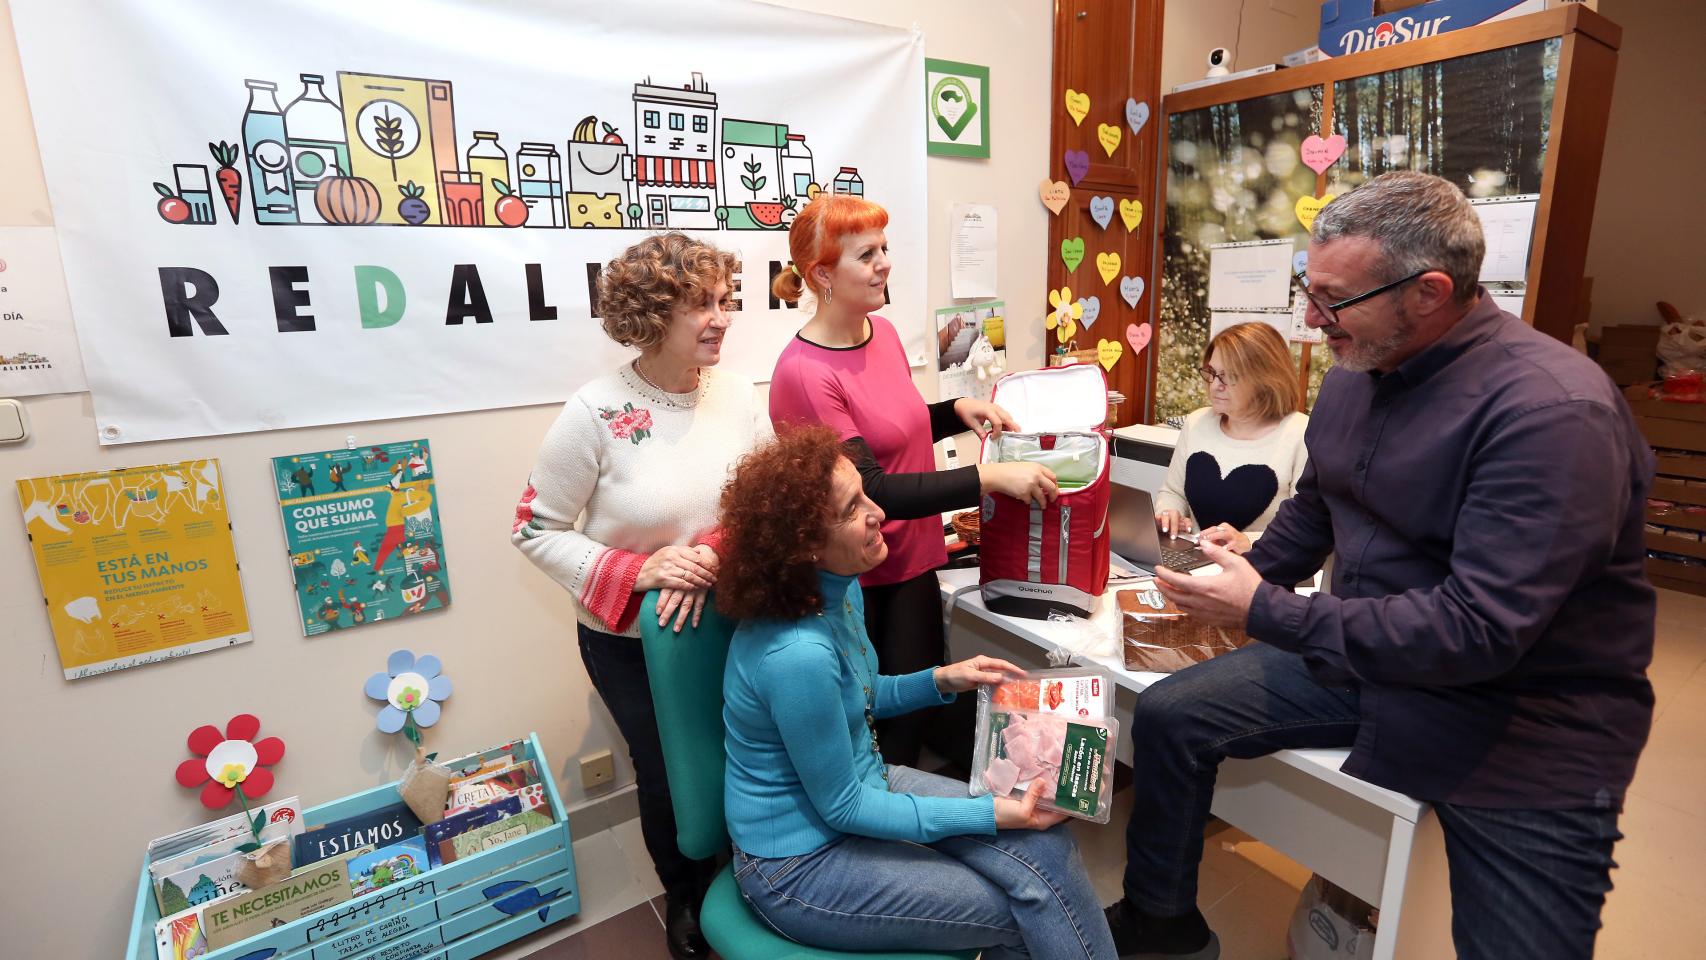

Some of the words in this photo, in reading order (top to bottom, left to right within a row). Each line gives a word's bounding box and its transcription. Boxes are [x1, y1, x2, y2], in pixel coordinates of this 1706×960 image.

[3, 312, 24, 321] DÍA
[292, 497, 374, 519] CONSUMO
[294, 516, 329, 533] QUE
[330, 509, 377, 527] SUMA
[97, 553, 142, 573] ESTÁ
[145, 551, 170, 565] EN
[101, 570, 137, 586] TUS
[140, 558, 209, 580] MANOS
[1017, 584, 1054, 596] Quechua
[1078, 737, 1087, 760] Lacón
[1076, 761, 1082, 772] en
[1071, 773, 1082, 798] lascas
[318, 820, 403, 859] ESTAMOS
[504, 828, 522, 840] Jane
[211, 909, 230, 927] TE
[232, 870, 341, 920] NECESITAMOS
[338, 934, 361, 947] LITRO
[365, 928, 375, 937] DE
[379, 915, 408, 931] CARIÑO
[367, 936, 377, 944] DE
